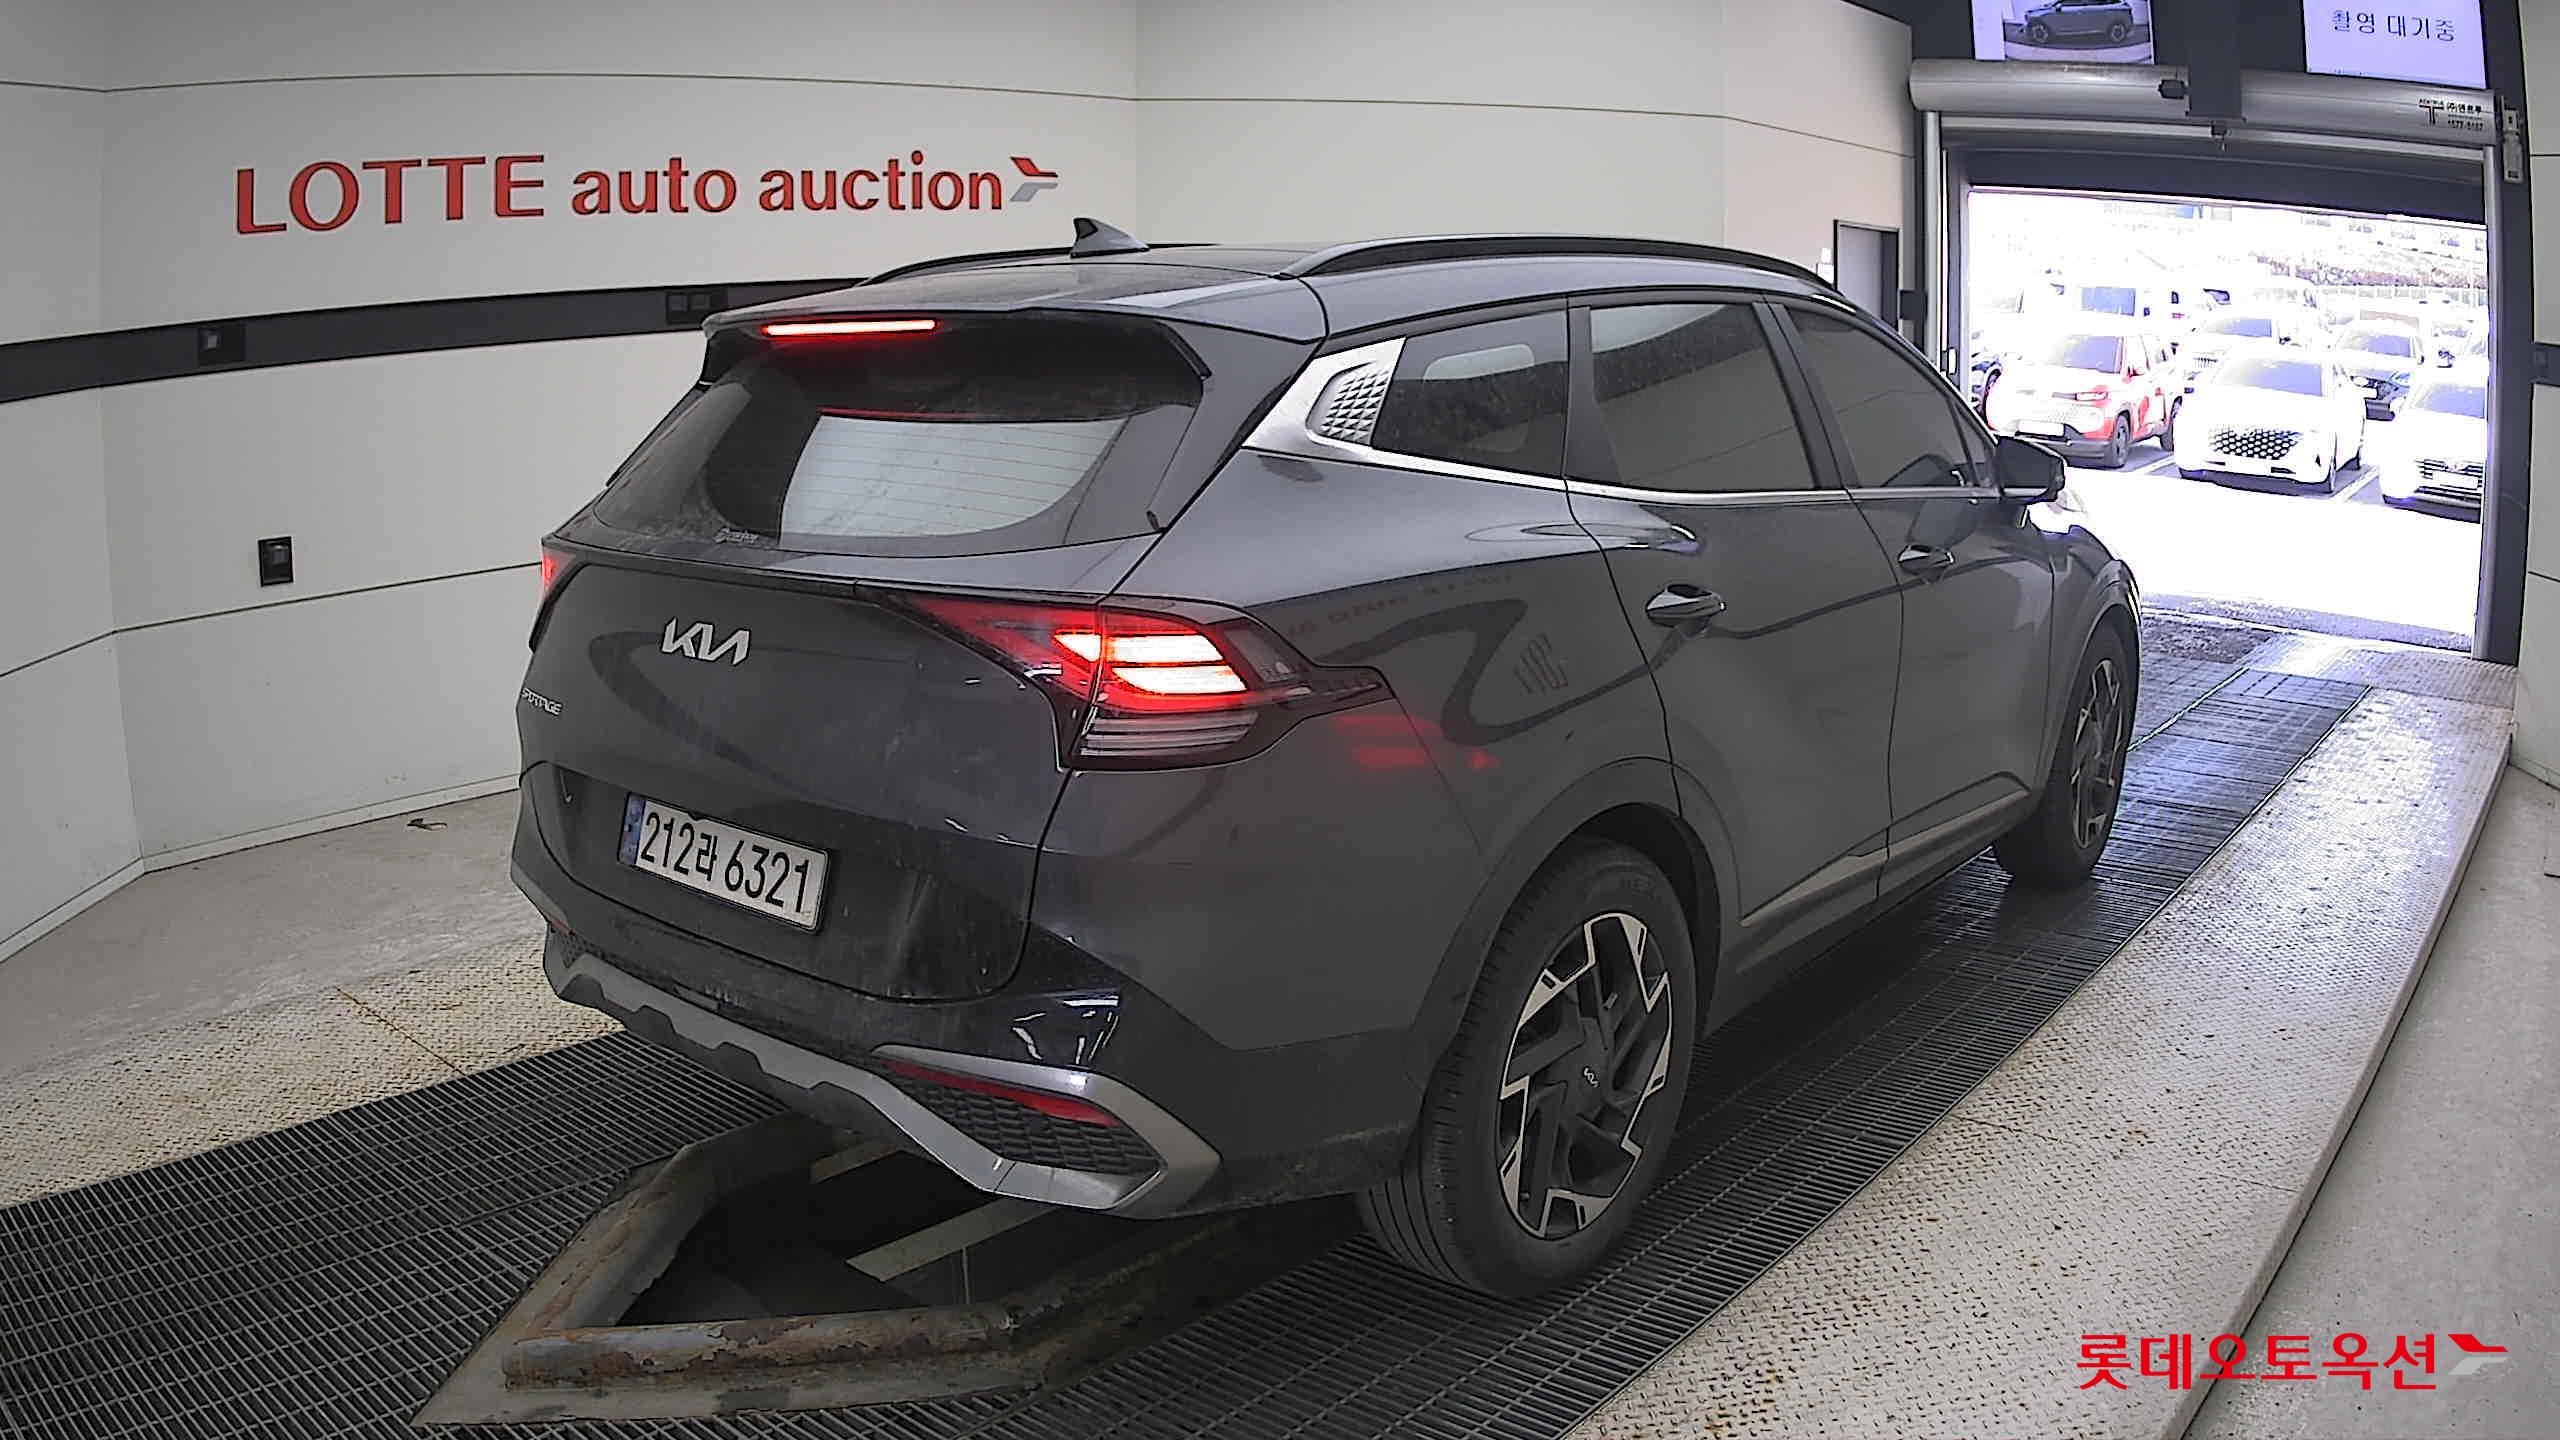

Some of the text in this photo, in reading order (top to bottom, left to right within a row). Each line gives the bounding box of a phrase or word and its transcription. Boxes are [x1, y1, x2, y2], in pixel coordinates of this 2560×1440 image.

[2387, 15, 2455, 42] 대기중
[236, 150, 1003, 234] LOTTE auto auction
[661, 618, 750, 665] KIA
[640, 812, 810, 913] 212라 6321
